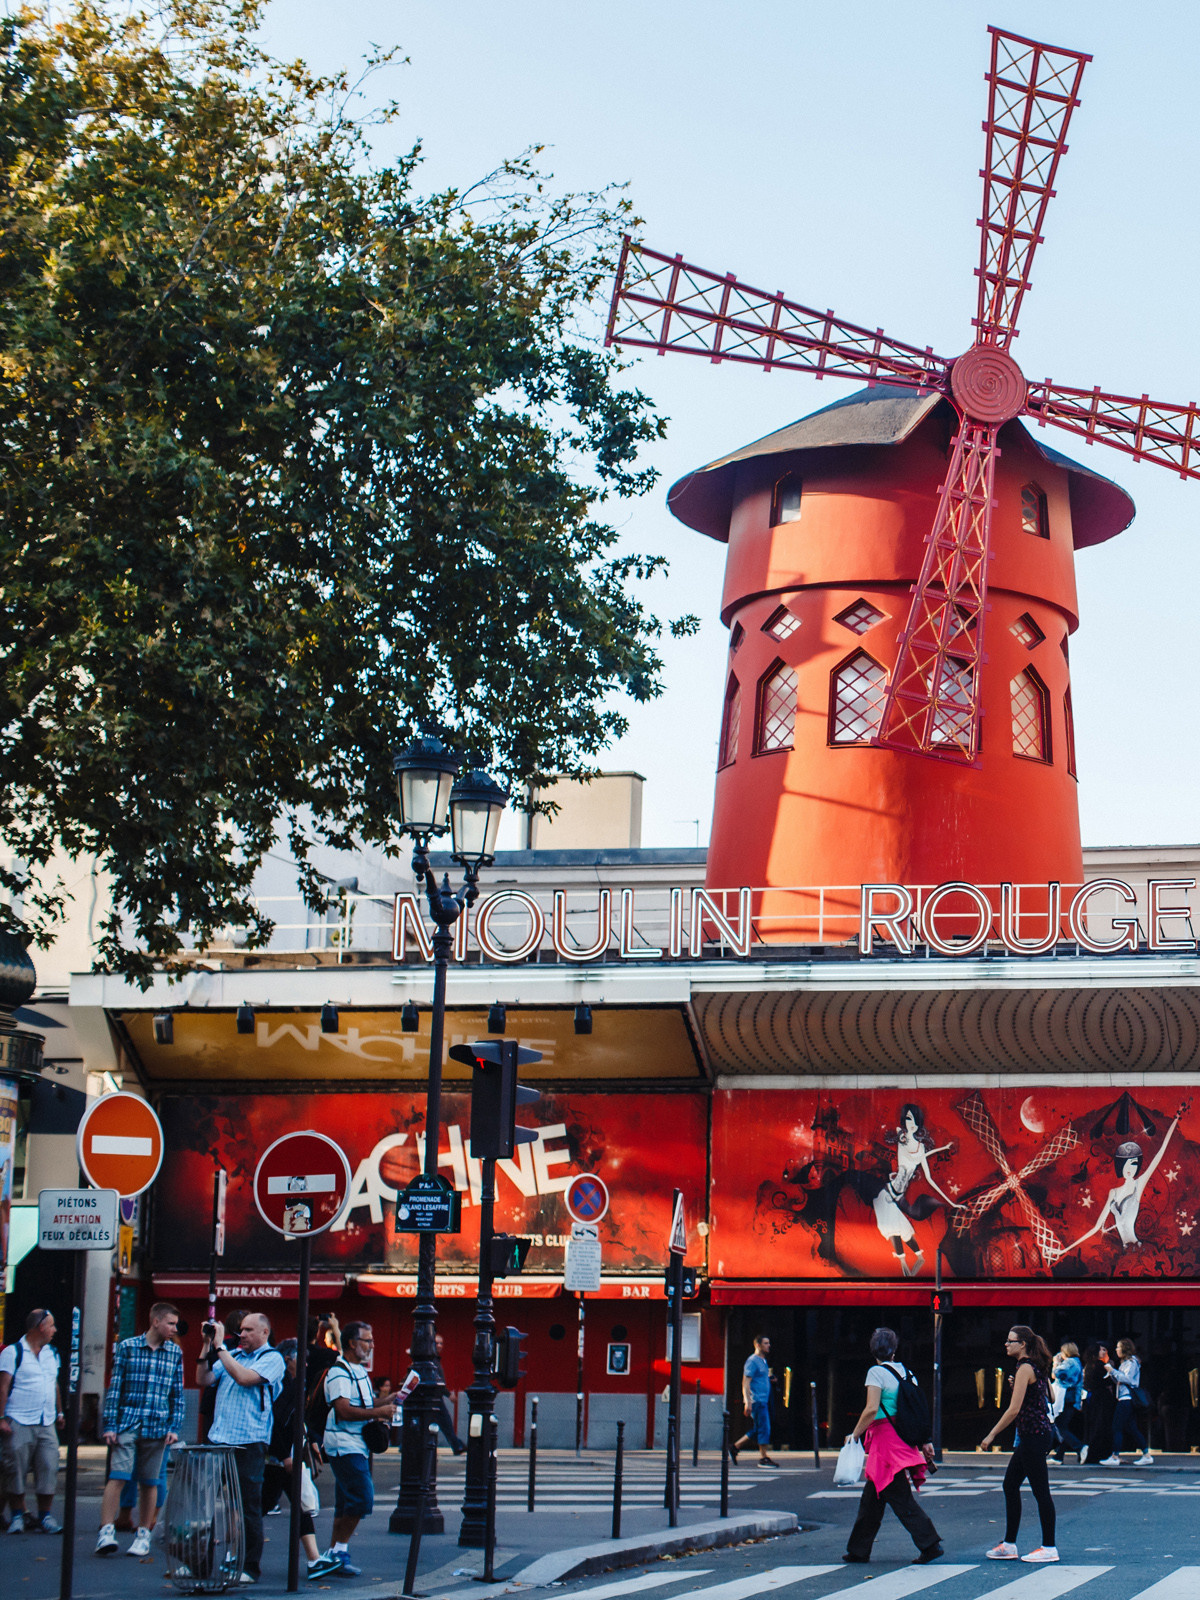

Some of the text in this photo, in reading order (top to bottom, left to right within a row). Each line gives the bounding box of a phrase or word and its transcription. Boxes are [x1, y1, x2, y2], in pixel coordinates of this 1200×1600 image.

[392, 877, 1198, 963] MOULIN ROUGE
[57, 1196, 97, 1208] PIÉTONS
[53, 1214, 101, 1224] ATTENTION
[42, 1229, 110, 1241] FEUX DÉCALÉS
[215, 1286, 281, 1297] TERRASSE
[396, 1284, 466, 1296] COERTS
[622, 1286, 650, 1297] BAR
